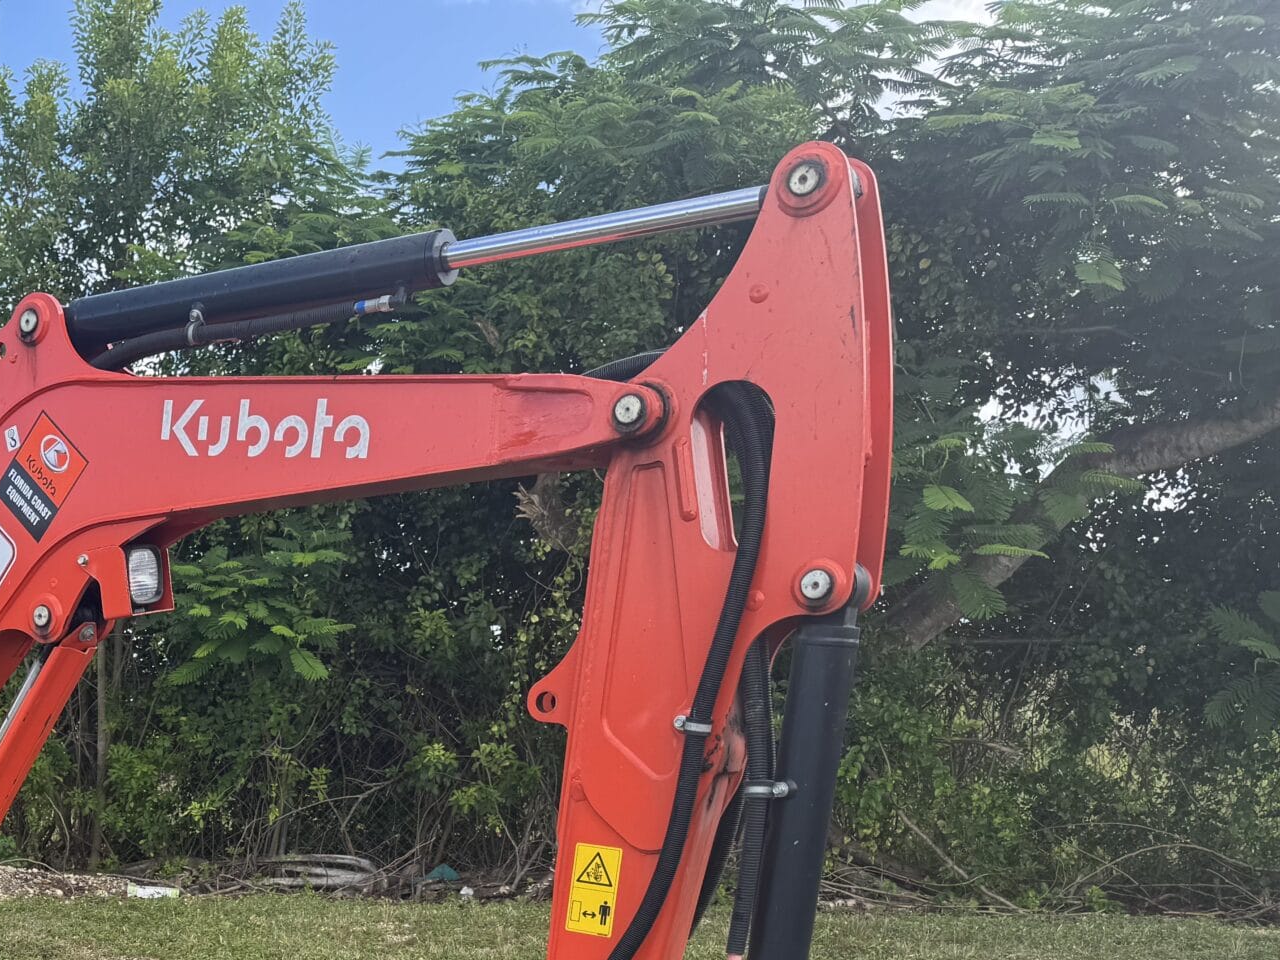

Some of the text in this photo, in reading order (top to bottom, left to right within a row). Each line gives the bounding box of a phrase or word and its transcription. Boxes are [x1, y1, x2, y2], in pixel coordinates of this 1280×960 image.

[160, 398, 370, 459] Kubota
[8, 468, 52, 520] FLORIDA COAST
[26, 454, 57, 496] Kubota
[5, 485, 41, 526] EQUIPMENT
